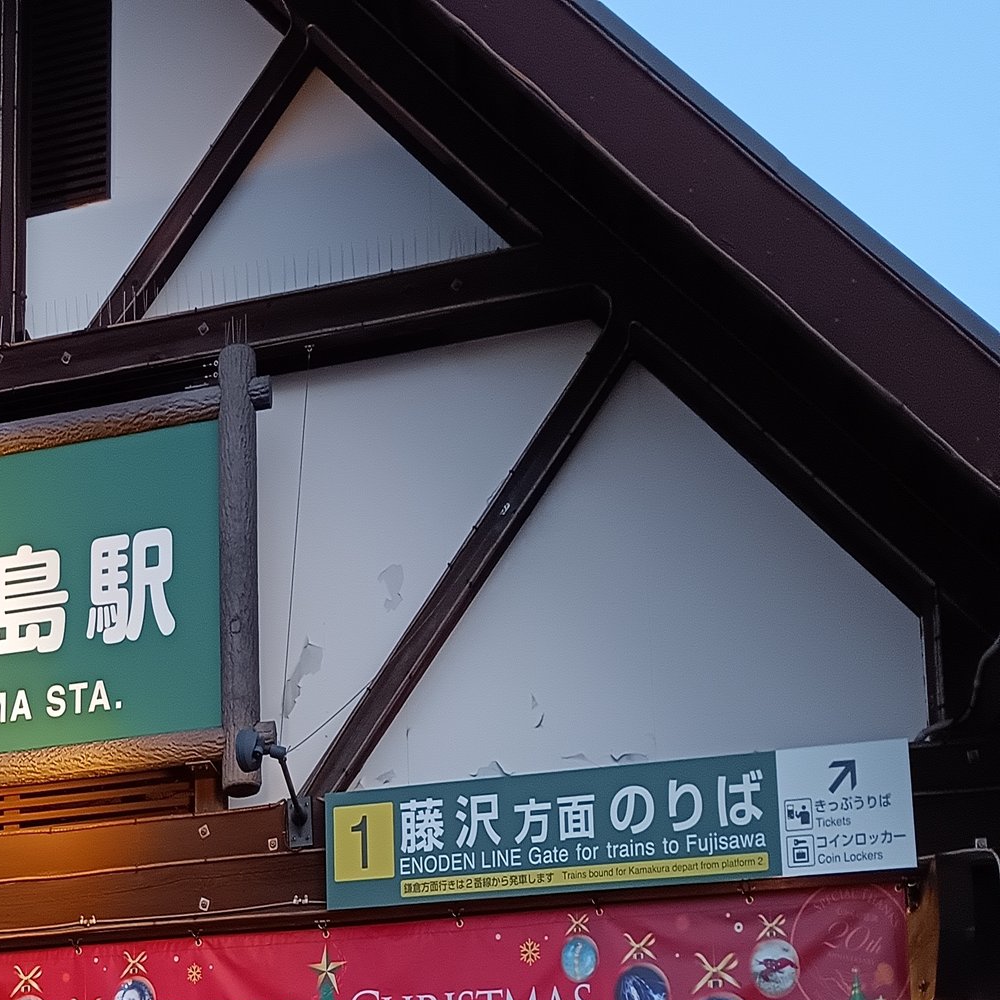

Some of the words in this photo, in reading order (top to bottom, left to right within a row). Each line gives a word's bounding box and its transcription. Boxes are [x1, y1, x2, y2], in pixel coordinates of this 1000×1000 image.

[45, 679, 123, 719] STA.
[814, 793, 891, 813] きっぷうりば
[815, 816, 852, 828] Tickets
[350, 814, 369, 870] 1
[816, 830, 906, 849] コインロッカー
[399, 852, 476, 875] ENODEN
[480, 848, 522, 869] LINE
[528, 846, 569, 865] Gate
[576, 844, 599, 861] for
[606, 838, 655, 860] trains
[662, 837, 679, 854] to
[685, 830, 767, 855] Fujisawa
[817, 853, 841, 864] Coin
[843, 851, 884, 862] Lockers
[561, 869, 588, 881] Trains
[589, 867, 615, 880] bound
[616, 867, 628, 877] for
[628, 863, 671, 876] Kamakura
[672, 861, 699, 874] depart
[699, 859, 720, 870] from
[721, 857, 756, 870] platform
[758, 857, 764, 866] 2
